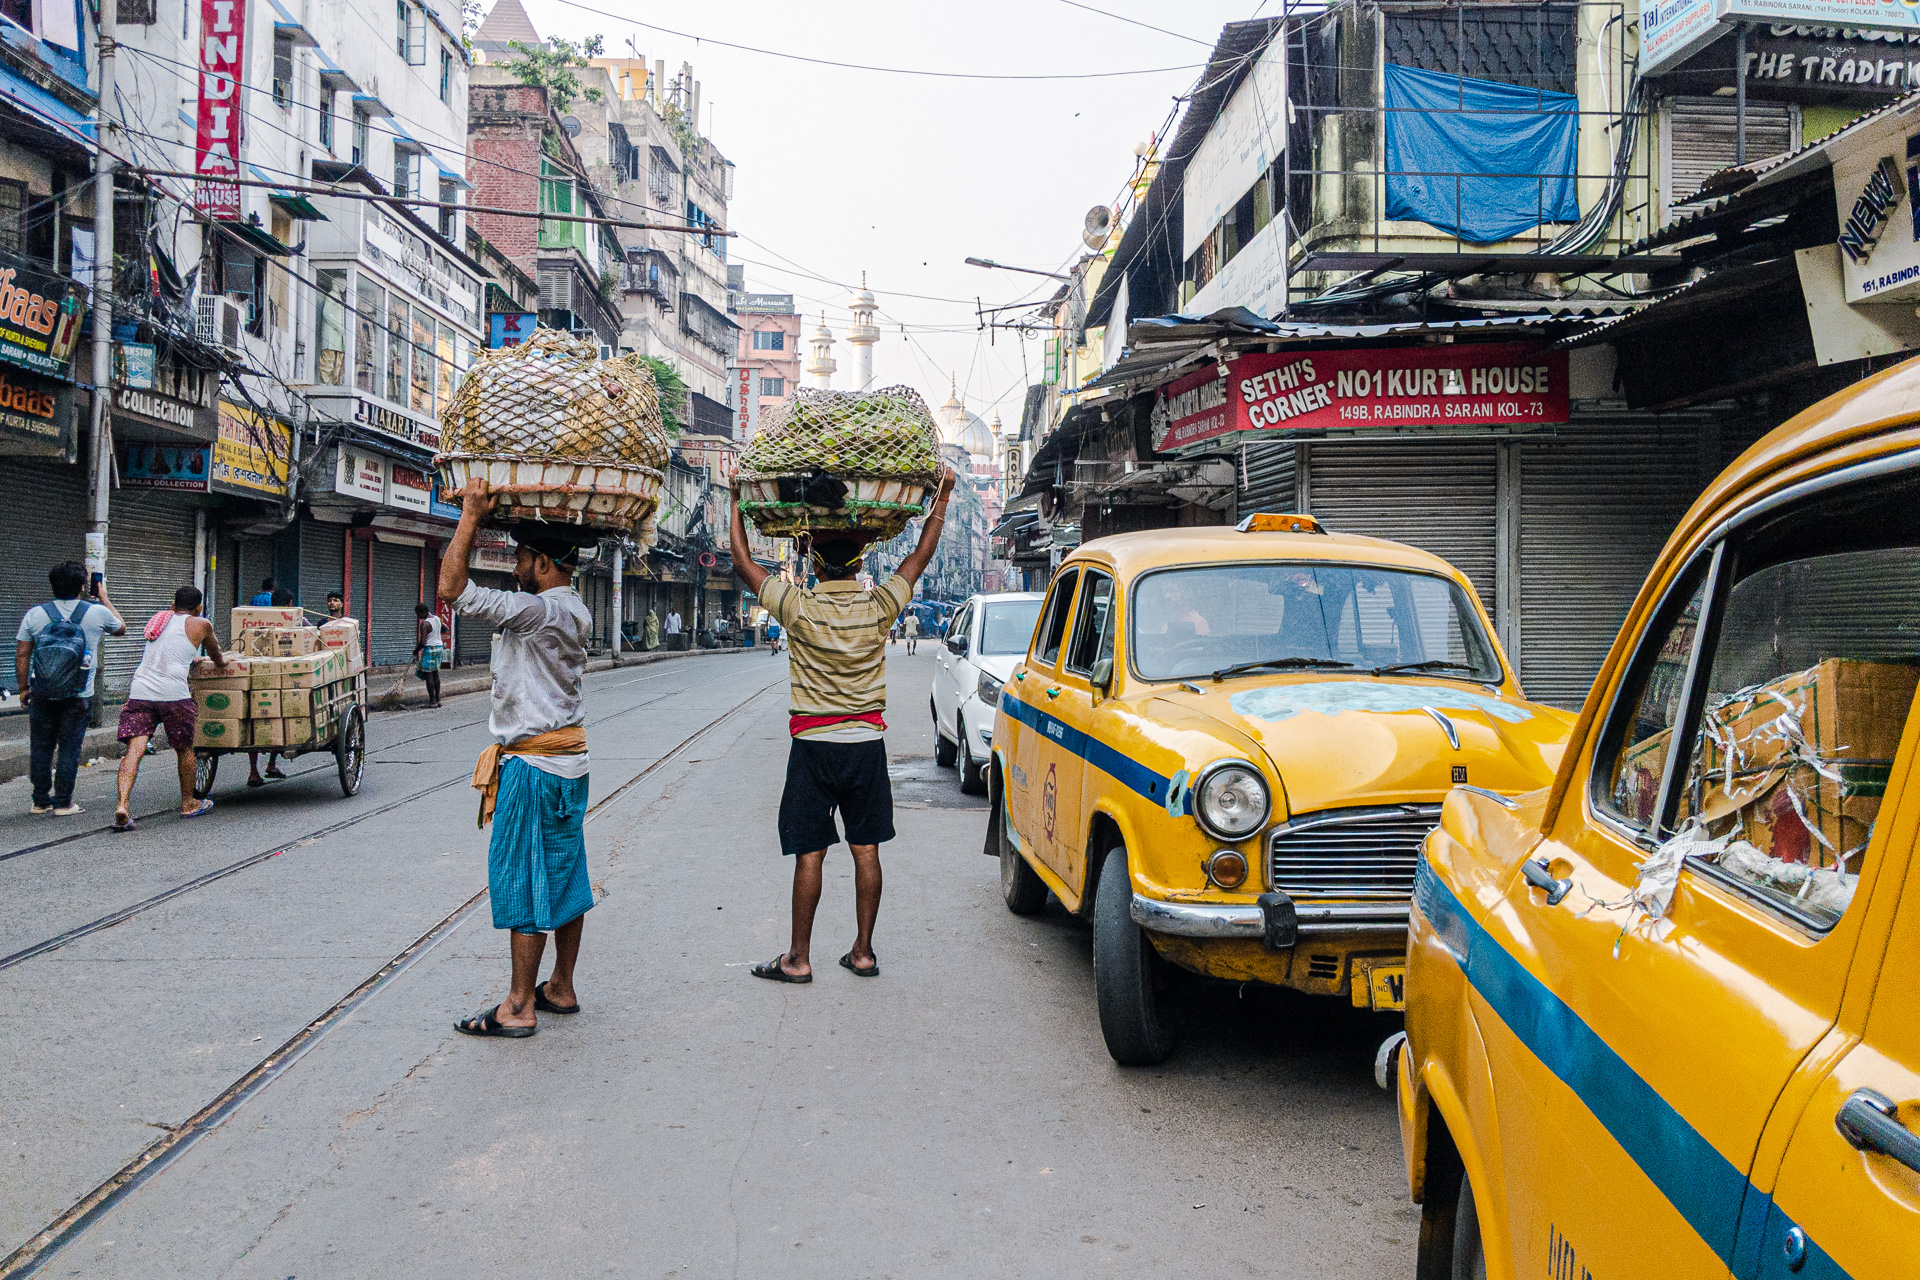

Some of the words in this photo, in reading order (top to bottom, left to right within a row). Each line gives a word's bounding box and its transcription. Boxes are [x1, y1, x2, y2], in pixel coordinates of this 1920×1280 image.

[1643, 4, 1658, 31] Taj
[1754, 0, 1787, 8] RABINDRA
[1850, 8, 1879, 17] KOLKATA
[1884, 10, 1905, 18] 700073
[1646, 39, 1655, 53] ALL
[1655, 31, 1668, 47] KINDS
[1669, 26, 1675, 38] OF
[1675, 20, 1685, 33] CAP
[1685, 2, 1711, 27] SUPPLIERS
[1745, 51, 1796, 79] THE
[200, 1, 238, 170] INDIA
[196, 190, 240, 206] HOUSE
[1837, 156, 1900, 266] NEW
[1862, 275, 1879, 294] 151,
[1879, 265, 1920, 288] RABINDR
[0, 267, 58, 336] baas
[1240, 358, 1316, 403] SETHI'S
[1337, 369, 1382, 397] NO1
[1471, 365, 1549, 394] HOUSE
[122, 389, 195, 428] COLLECTION
[1339, 405, 1372, 421] 149B,
[1374, 404, 1441, 419] RABINDRA
[1445, 402, 1493, 418] SARANI
[688, 456, 711, 466] RETAL
[154, 479, 205, 488] COLLECTION
[242, 618, 284, 628] fortune
[199, 665, 236, 676] fortune
[1452, 767, 1466, 781] HM
[1375, 984, 1389, 992] IND
